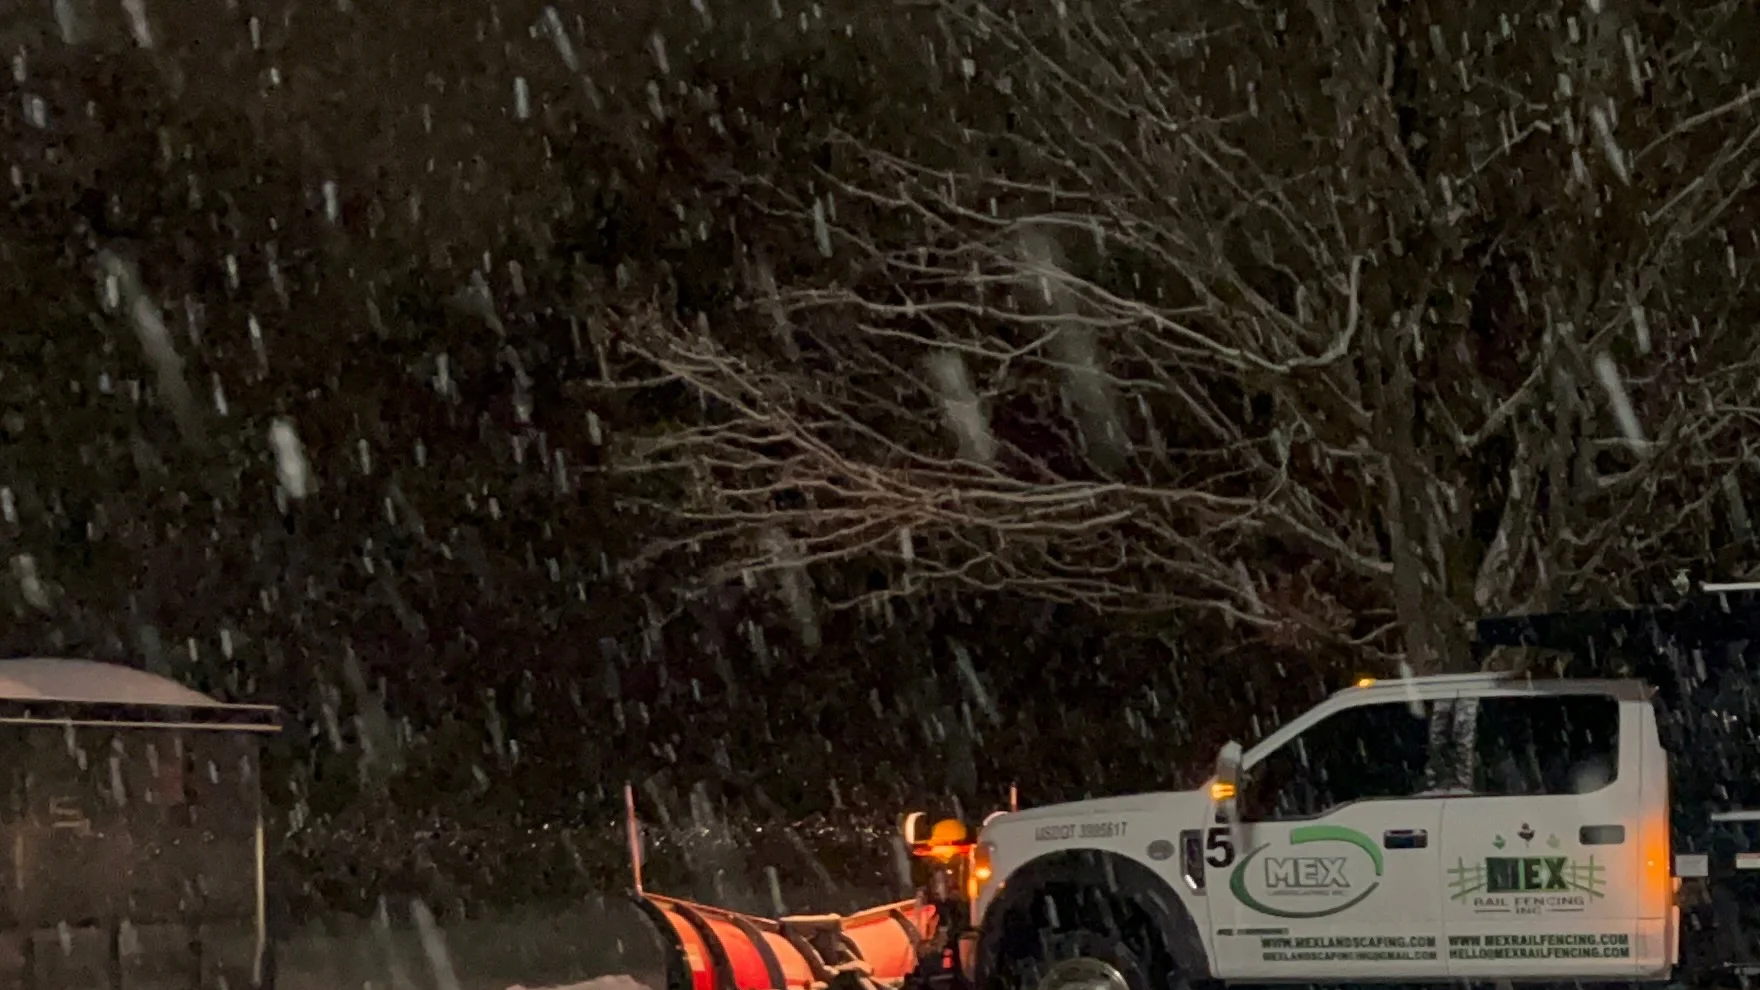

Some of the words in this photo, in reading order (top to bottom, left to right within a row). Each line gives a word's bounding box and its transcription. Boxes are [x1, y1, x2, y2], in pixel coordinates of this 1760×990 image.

[1206, 827, 1235, 868] 5
[1264, 857, 1351, 888] MEX
[1485, 857, 1569, 893] MEX
[1473, 897, 1509, 907] RAIL
[1514, 896, 1585, 906] FENCING
